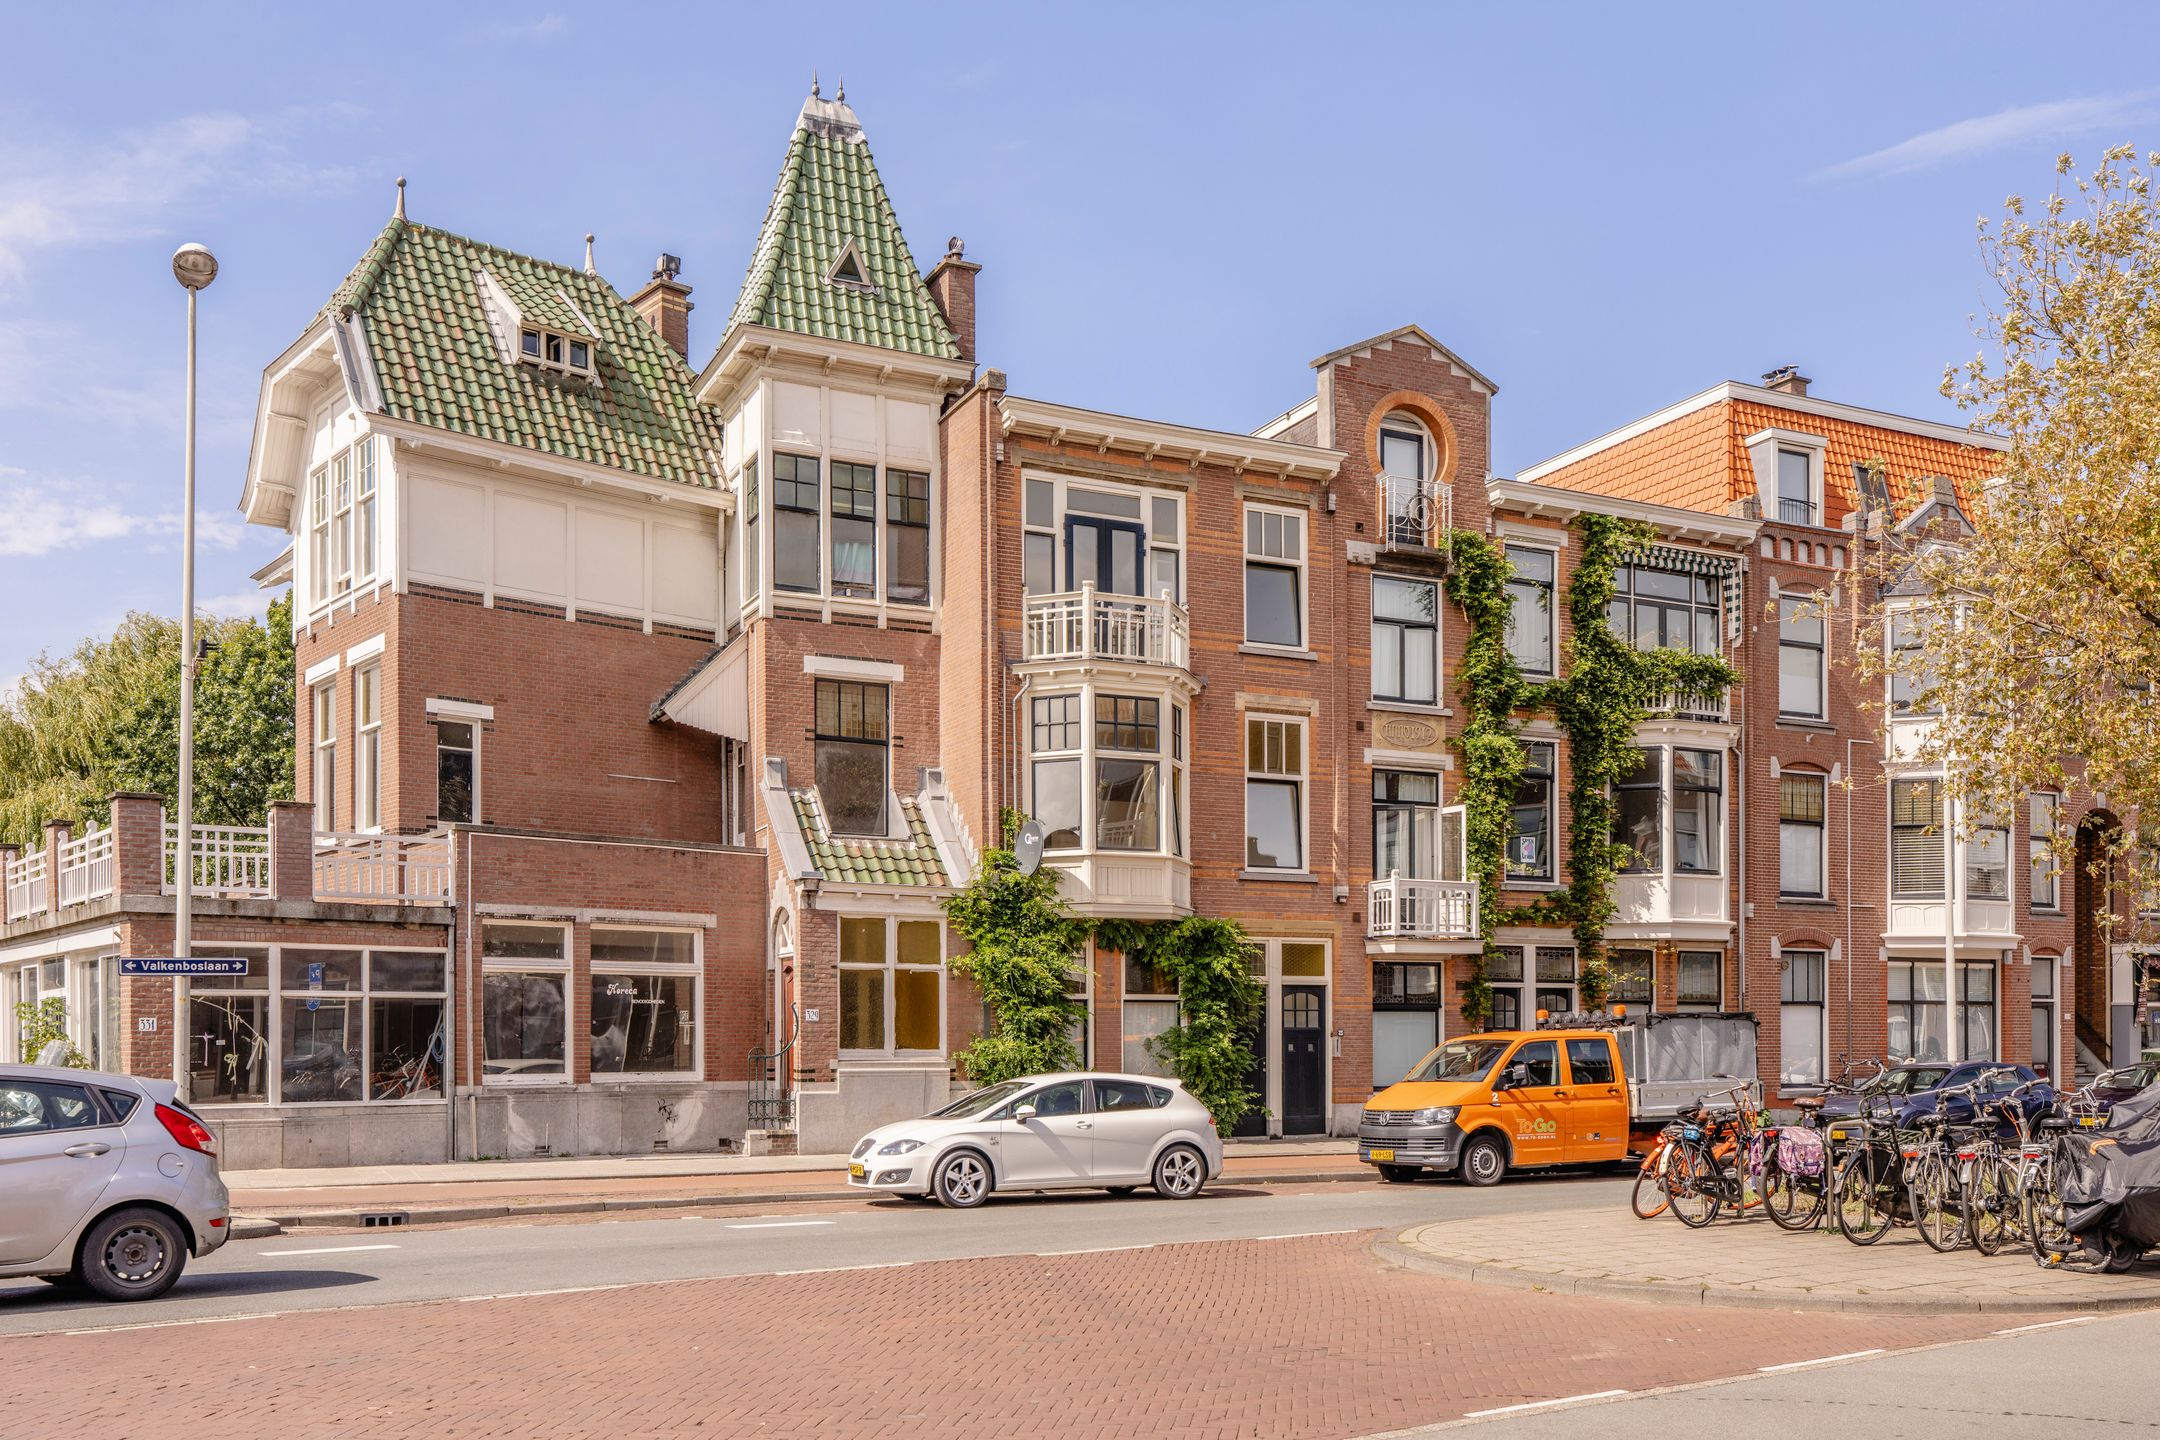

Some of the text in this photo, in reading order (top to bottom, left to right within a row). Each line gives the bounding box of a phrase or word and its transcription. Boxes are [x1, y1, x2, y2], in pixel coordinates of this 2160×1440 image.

[140, 961, 229, 971] Valkenboslaan
[606, 983, 638, 996] Horeca
[1491, 1092, 1499, 1102] 2
